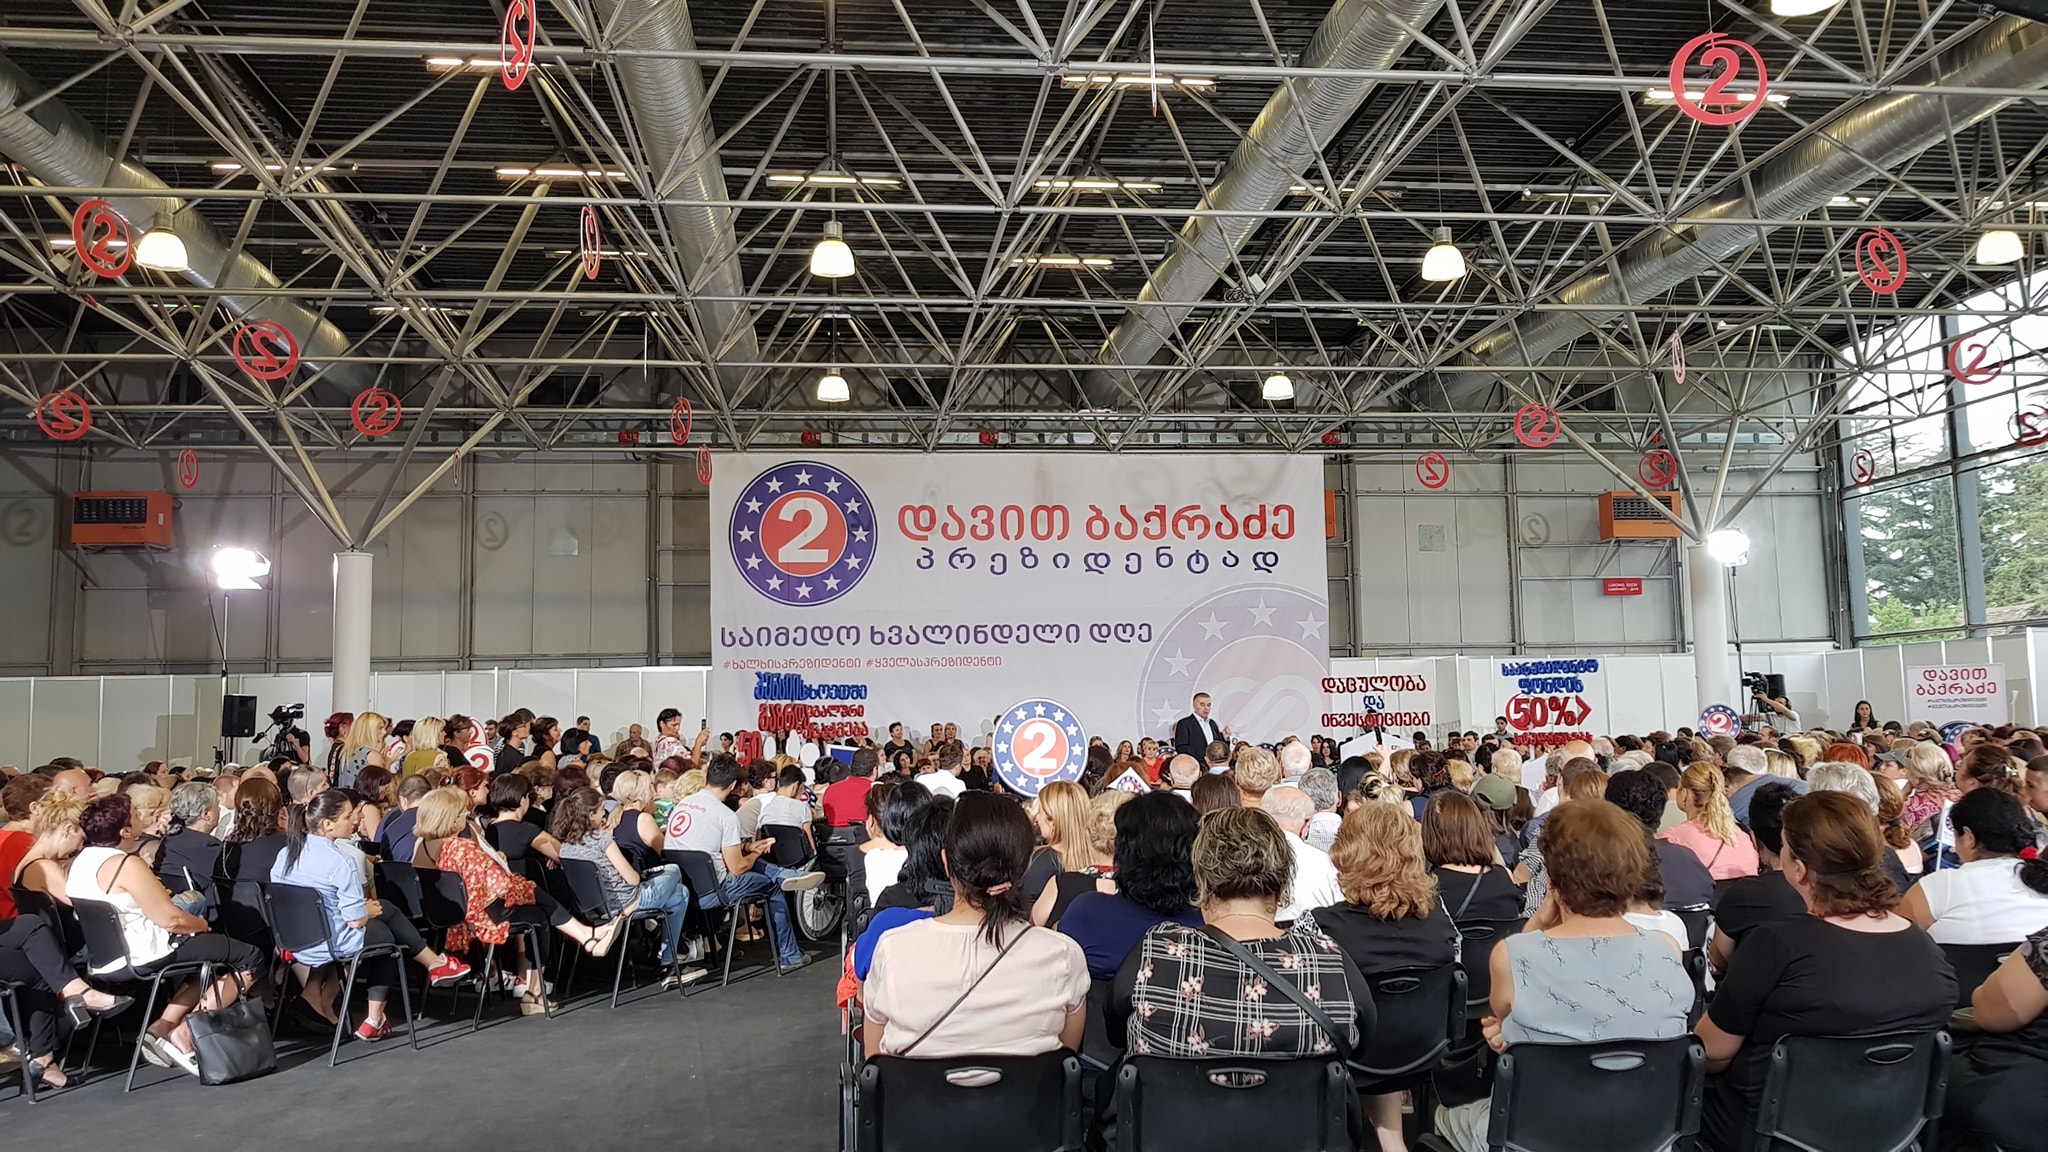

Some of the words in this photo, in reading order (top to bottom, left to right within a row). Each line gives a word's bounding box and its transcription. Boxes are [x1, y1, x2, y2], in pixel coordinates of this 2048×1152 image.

[1701, 48, 1740, 106] 2
[91, 212, 118, 263] 2
[778, 496, 830, 564] 2
[898, 504, 1071, 541] დავით
[1085, 504, 1296, 541] ბაქრაძე
[916, 546, 1280, 575] პრეზიდენტად
[721, 625, 861, 647] საიმედო
[870, 623, 1081, 645] ხვალინდელი
[1089, 622, 1153, 643] დღე
[723, 658, 862, 670] #ხალხისპრეზიდენტი
[866, 656, 1002, 669] #ყველასპრეზიდენტი
[1321, 674, 1427, 693] დაცულობა
[1922, 668, 1987, 681] დავით
[1916, 682, 1997, 696] ბაქრაძე
[1363, 695, 1385, 709] და
[1321, 711, 1431, 727] ინვესტიციები
[1710, 713, 1728, 733] 2
[1023, 722, 1058, 769] 2
